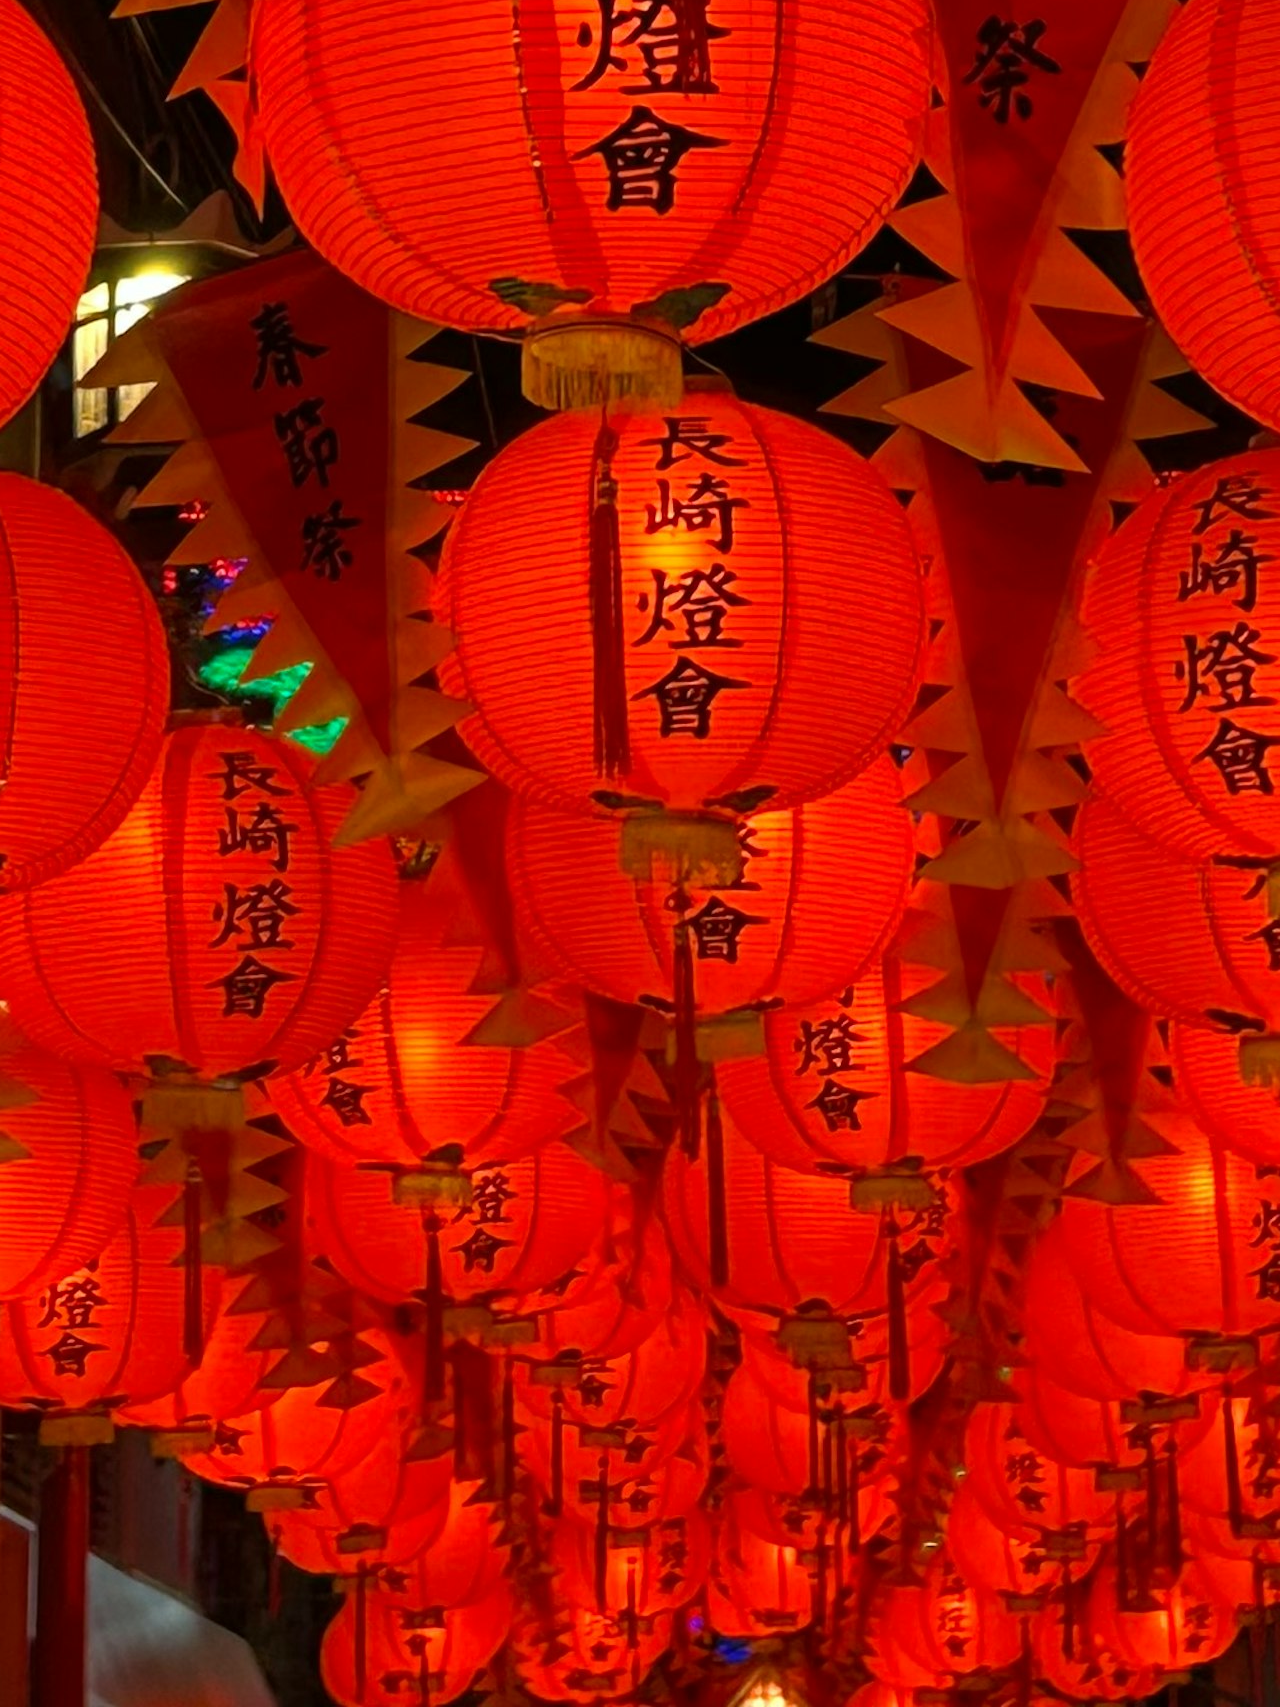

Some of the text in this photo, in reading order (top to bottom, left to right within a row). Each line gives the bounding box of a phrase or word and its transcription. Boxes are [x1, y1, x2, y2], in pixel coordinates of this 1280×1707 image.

[249, 301, 363, 582] 春節祭
[629, 416, 754, 740] 長崎燈會
[206, 751, 302, 1019] 長崎燈會
[792, 987, 882, 1132] 燈會
